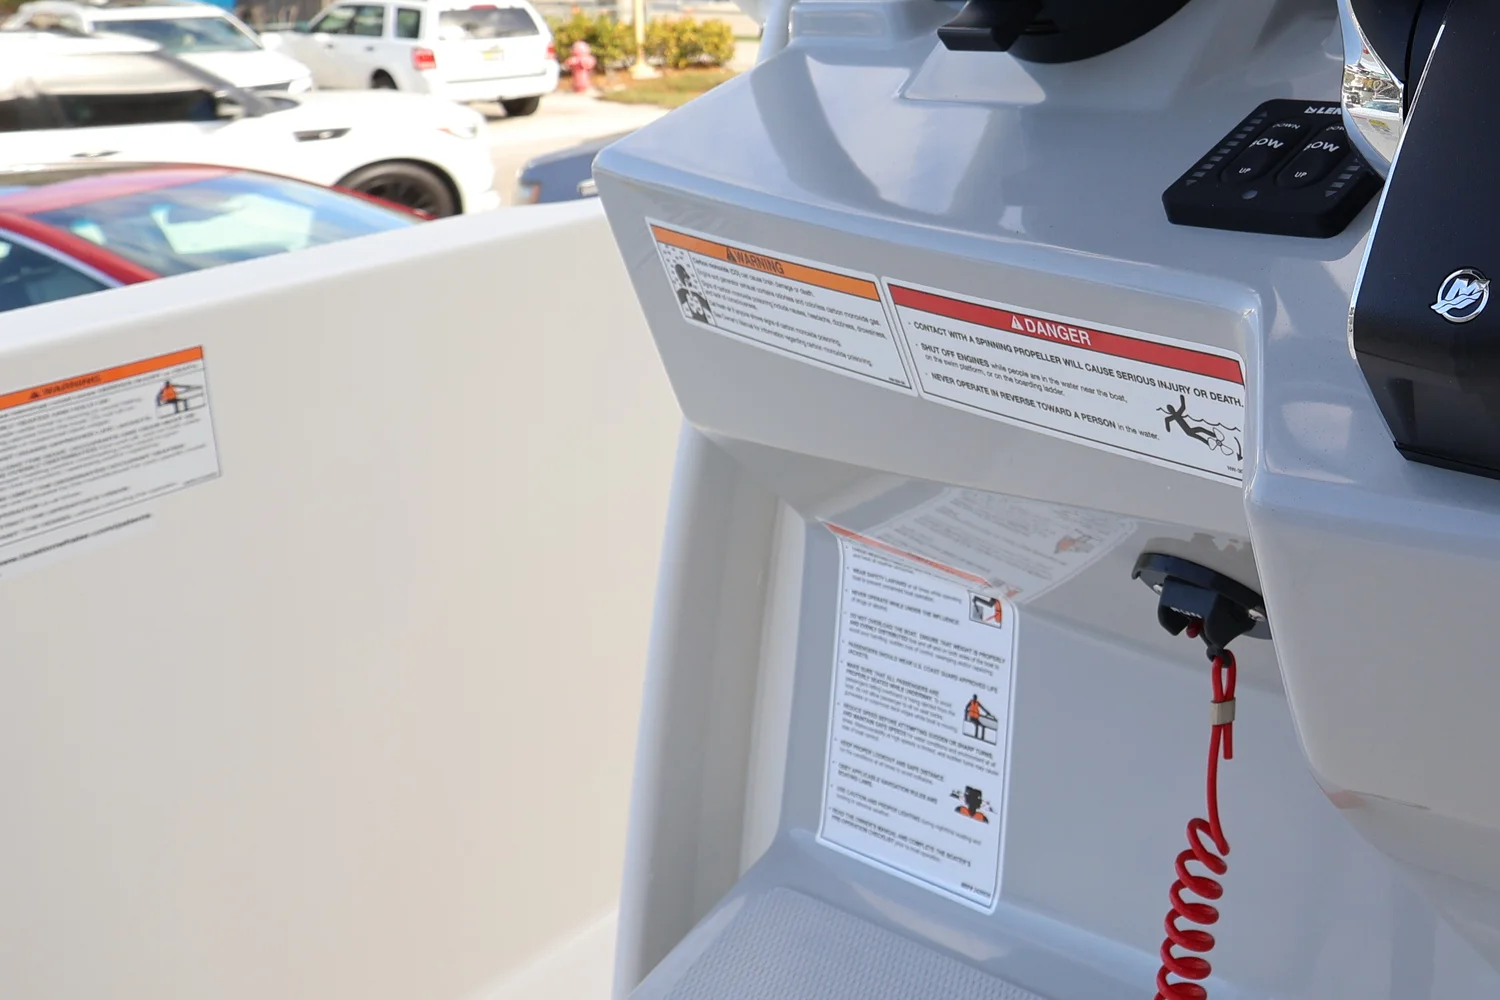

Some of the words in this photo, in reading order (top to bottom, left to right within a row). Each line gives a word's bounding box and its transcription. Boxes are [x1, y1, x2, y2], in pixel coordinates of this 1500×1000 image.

[1316, 107, 1342, 115] LEN
[708, 262, 729, 272] monoxide
[737, 250, 785, 275] WARNING
[1025, 317, 1091, 346] DANGER
[912, 320, 947, 337] CONTACT
[947, 329, 968, 342] WITH
[967, 335, 975, 343] A
[974, 336, 1012, 353] SPINNING
[1013, 346, 1062, 365] PROPELLER
[1062, 358, 1083, 370] WILL
[1084, 363, 1115, 377] CAUSE
[1115, 370, 1156, 387] SERIOUS
[1157, 379, 1190, 394] INJURY
[1193, 387, 1208, 399] OR
[1210, 392, 1244, 408] DEATH.
[920, 342, 940, 354] SHUT
[940, 348, 956, 359] OFF
[956, 352, 989, 367] ENGINES
[990, 362, 1006, 372] while
[1007, 366, 1029, 379] people
[1048, 377, 1060, 385] the
[1060, 380, 1078, 390] water
[1080, 385, 1095, 394] near
[1096, 389, 1108, 398] the
[932, 355, 942, 363] the
[943, 359, 959, 368] swim
[993, 372, 1002, 380] on
[1002, 374, 1013, 382] the
[1014, 377, 1042, 391] boarding
[930, 371, 955, 385] NEVER
[955, 378, 990, 395] OPERATE
[990, 388, 999, 397] IN
[999, 391, 1035, 407] REVERSE
[1036, 401, 1072, 417] TOWARD
[1073, 411, 1081, 419] A
[1081, 413, 1116, 429] PERSON
[1125, 425, 1137, 434] the
